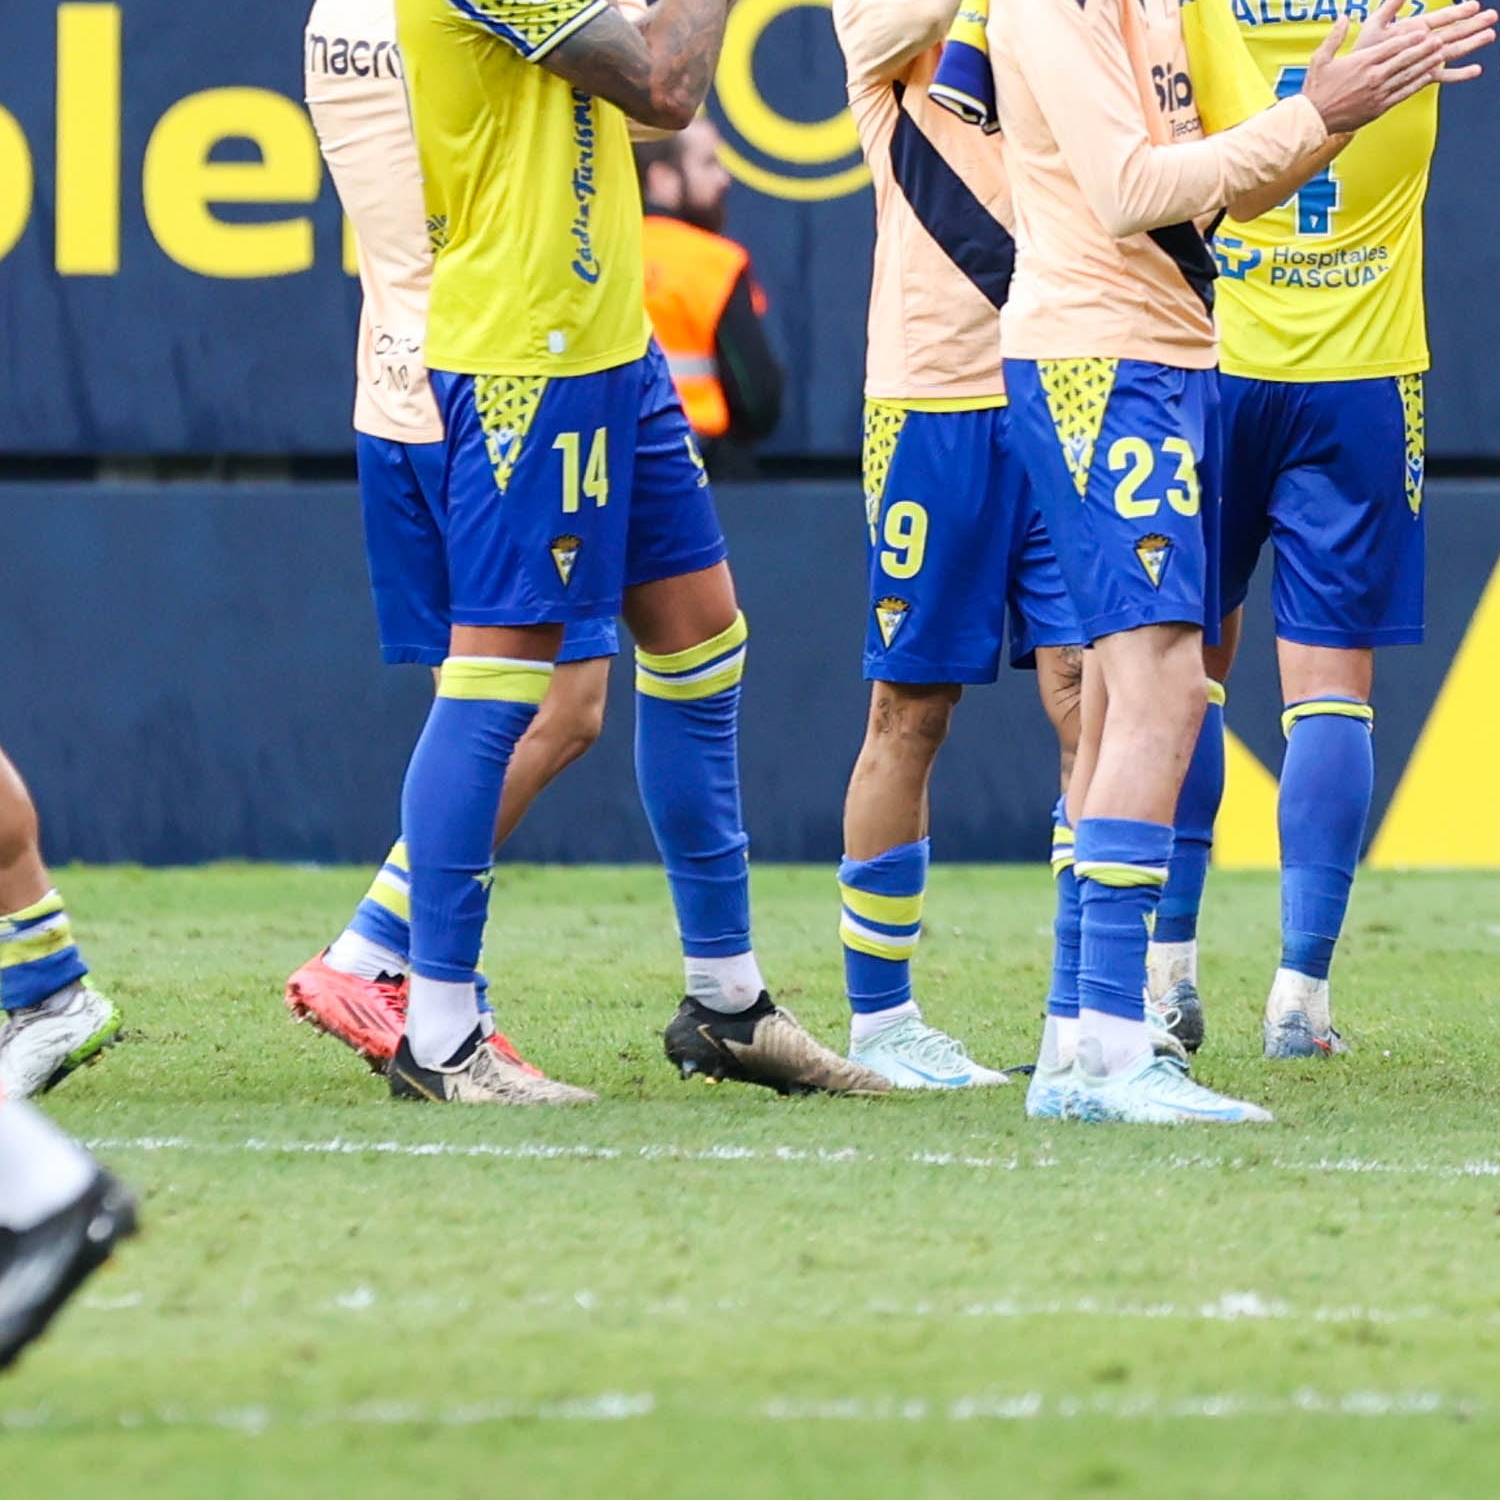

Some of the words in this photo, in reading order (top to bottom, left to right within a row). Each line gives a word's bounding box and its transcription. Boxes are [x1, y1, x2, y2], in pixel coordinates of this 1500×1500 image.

[1273, 246, 1388, 268] Hospitales
[552, 426, 610, 513] 14
[1107, 436, 1200, 519] 23
[880, 500, 928, 579] 9
